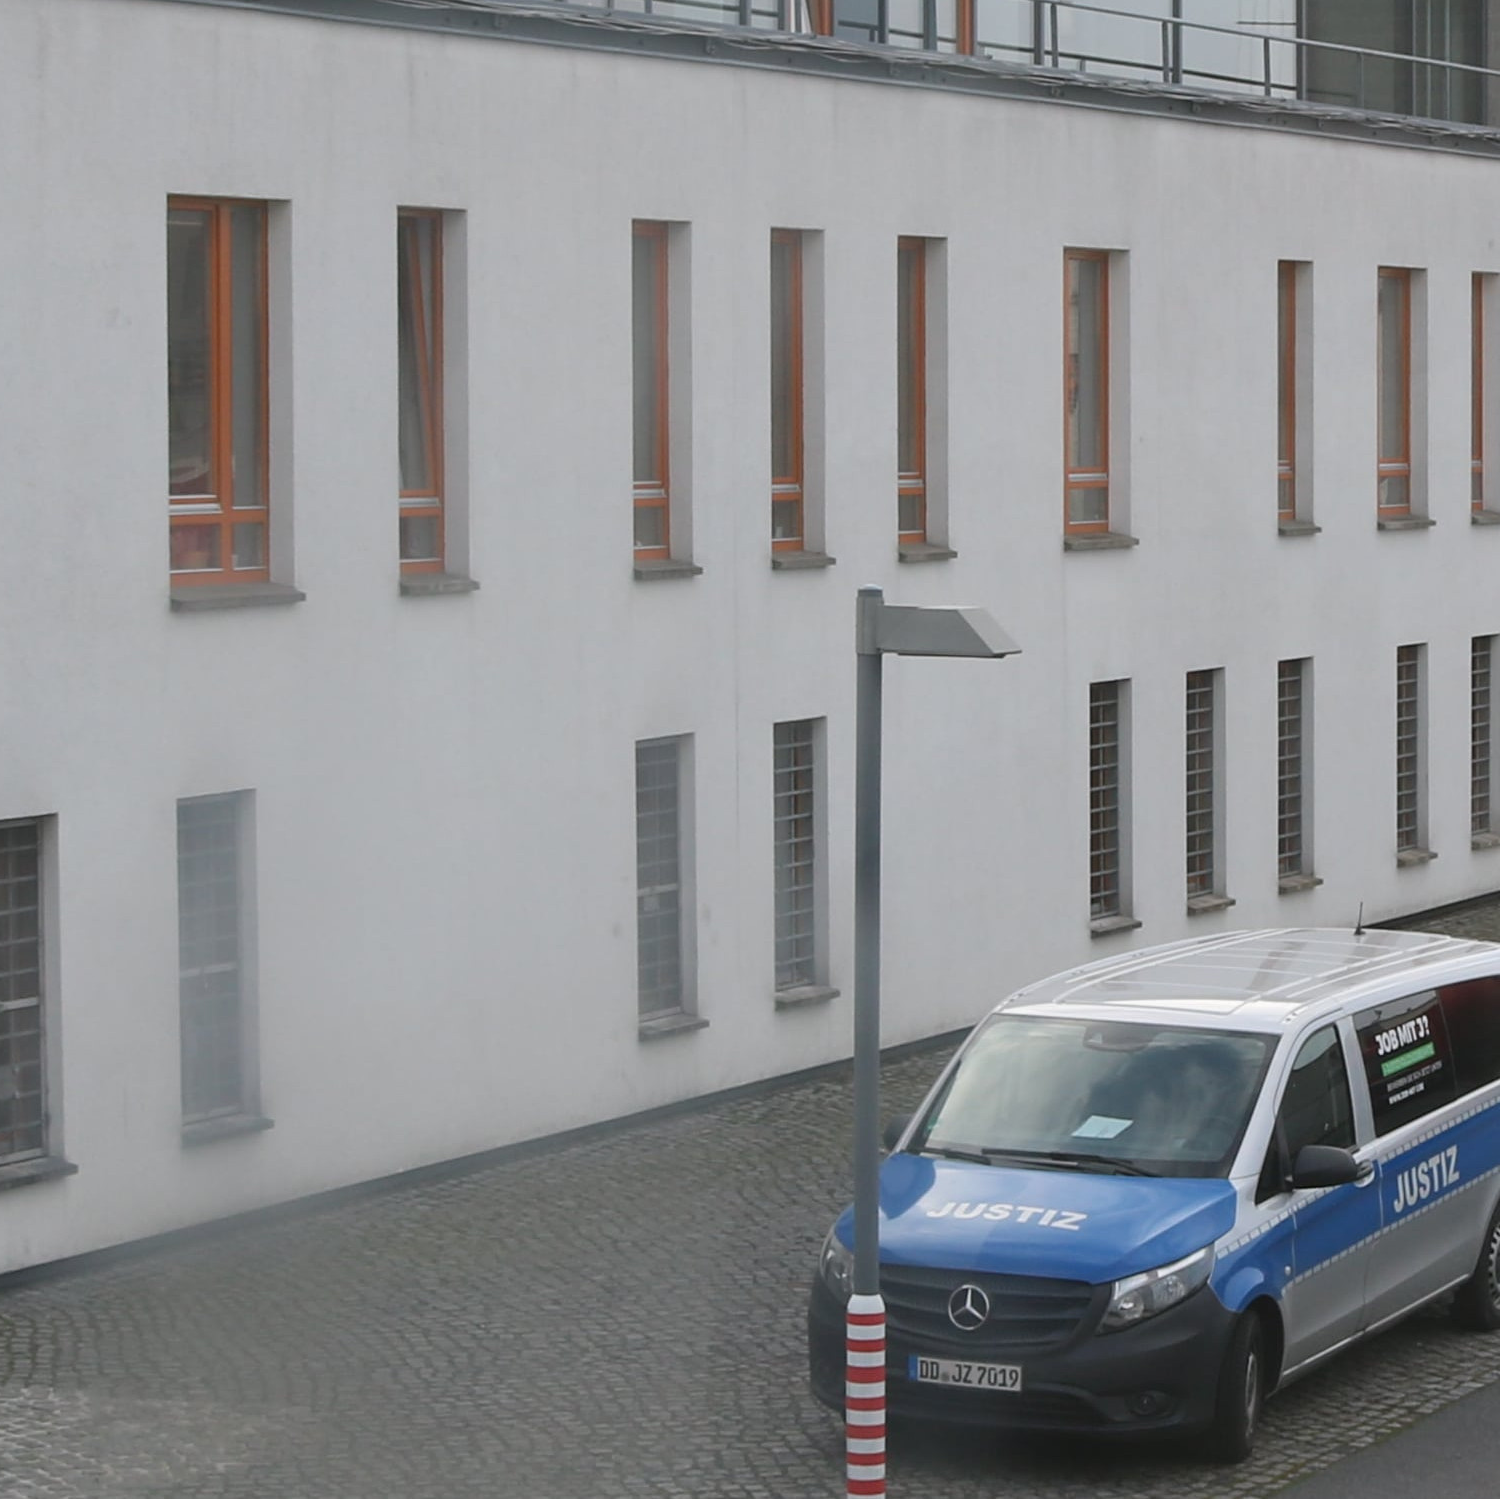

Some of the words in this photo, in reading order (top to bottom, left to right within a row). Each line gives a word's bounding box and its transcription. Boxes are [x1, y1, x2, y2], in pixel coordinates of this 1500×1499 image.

[1375, 1029, 1400, 1056] JOB
[1396, 1020, 1418, 1047] MIT
[1416, 1015, 1430, 1038] J?
[1393, 1144, 1460, 1213] JUSTIZ
[926, 1202, 1088, 1231] JUSTIZ
[920, 1360, 940, 1380] DD
[951, 1363, 973, 1384] JZ
[977, 1366, 1019, 1388] 7019
